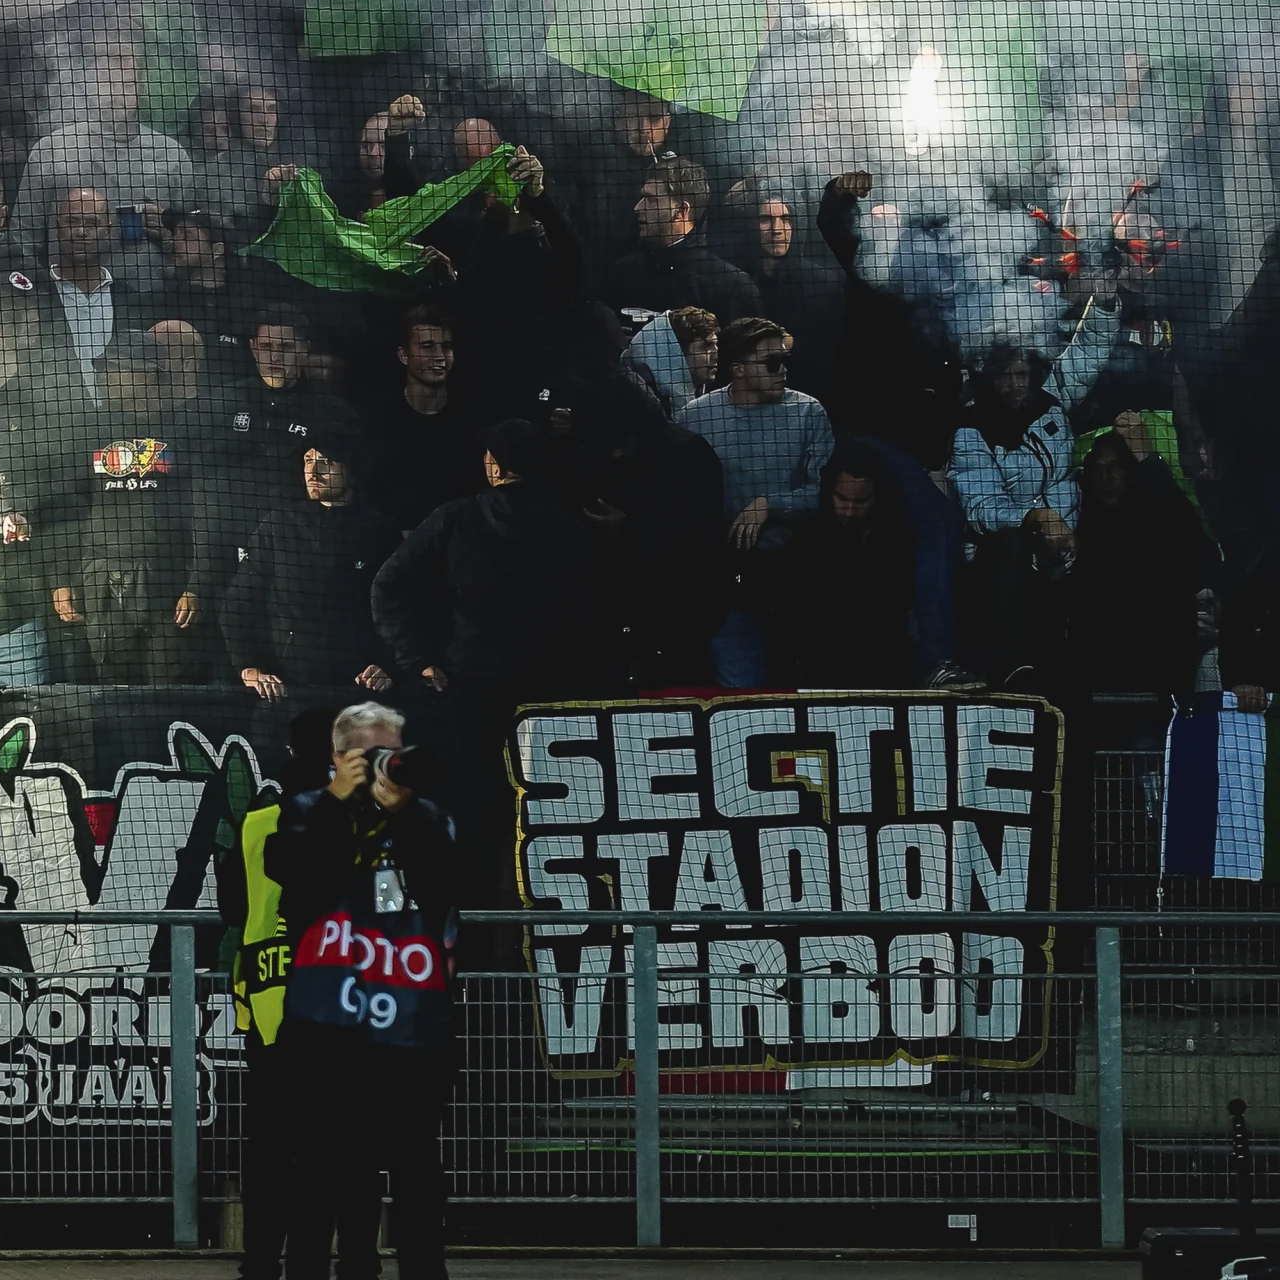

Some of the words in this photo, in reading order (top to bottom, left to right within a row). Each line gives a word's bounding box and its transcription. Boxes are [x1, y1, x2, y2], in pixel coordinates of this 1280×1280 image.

[517, 705, 1036, 825] SECTIE
[527, 821, 1032, 936] STADION
[316, 919, 435, 983] PHOTO
[534, 932, 1026, 1056] VERBOD
